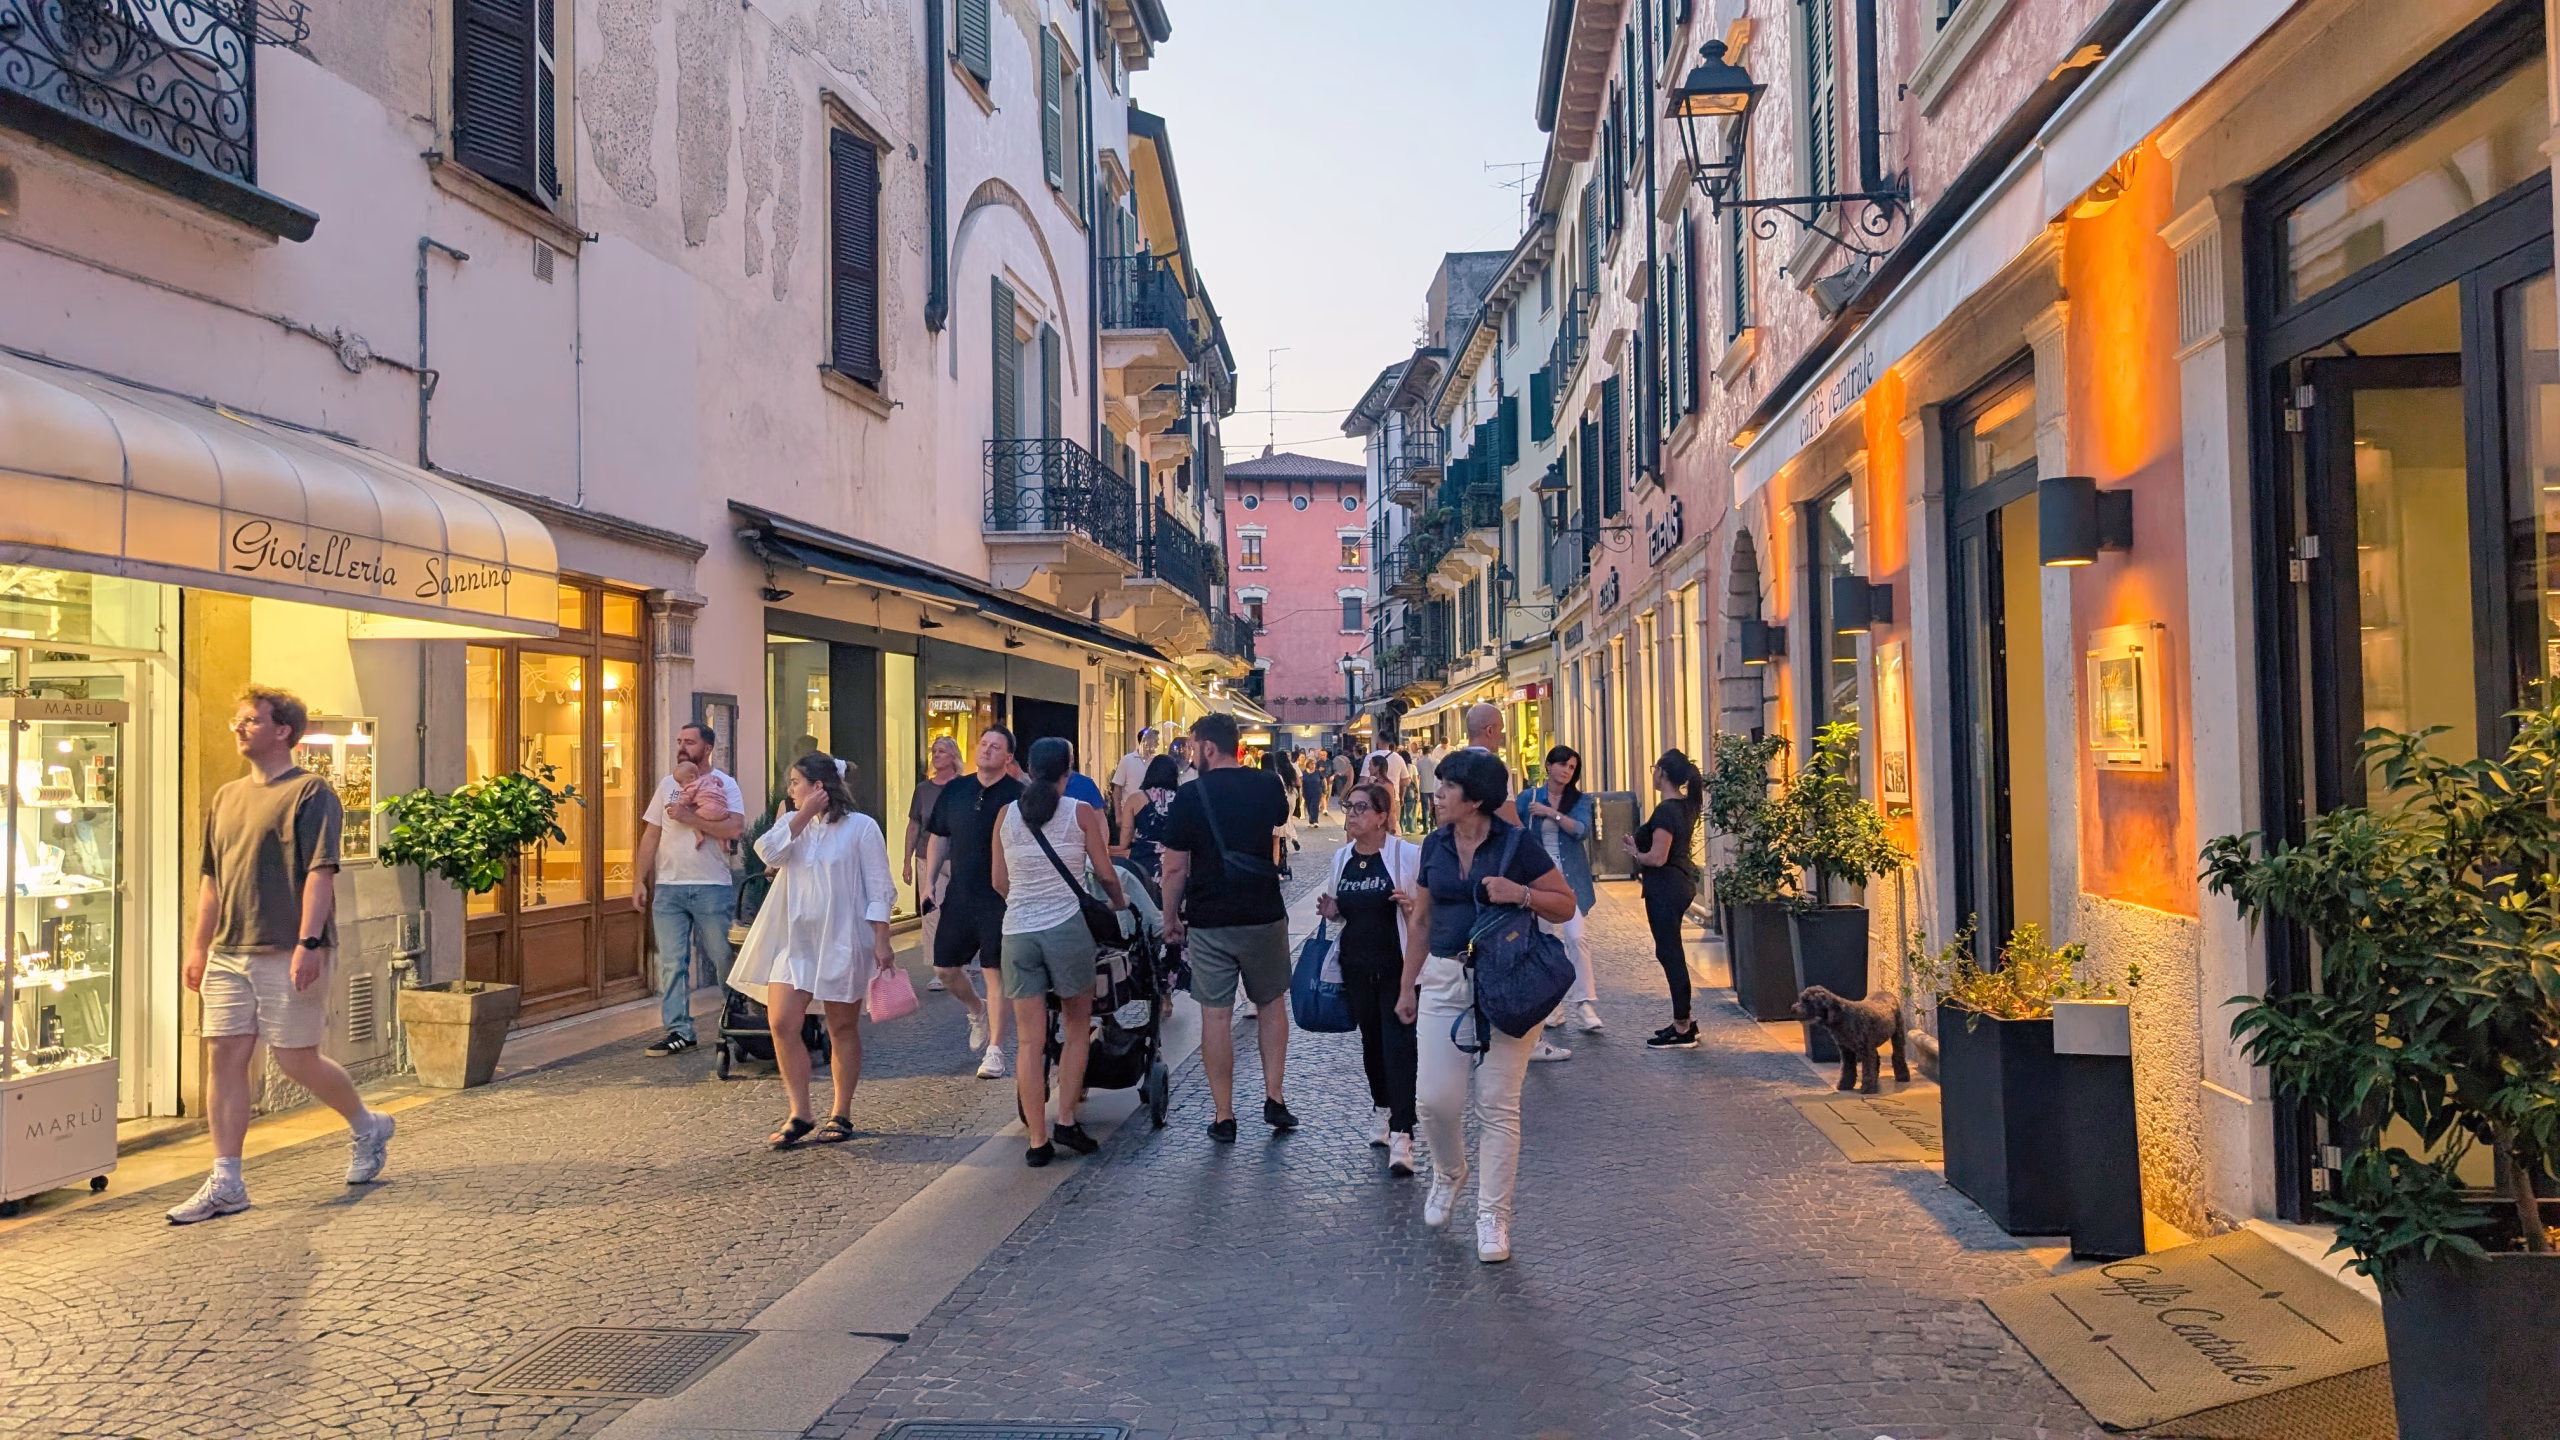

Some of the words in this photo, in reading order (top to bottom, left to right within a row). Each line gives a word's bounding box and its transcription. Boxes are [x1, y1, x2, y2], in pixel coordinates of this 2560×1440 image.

[232, 520, 397, 586] Gioielleria
[415, 557, 512, 598] Sannino
[45, 701, 104, 716] MARLÙ
[1338, 876, 1388, 892] freddy
[25, 1103, 102, 1140] MARLÙ
[2095, 1263, 2193, 1306] Caffè
[2157, 1308, 2297, 1386] Centrale
